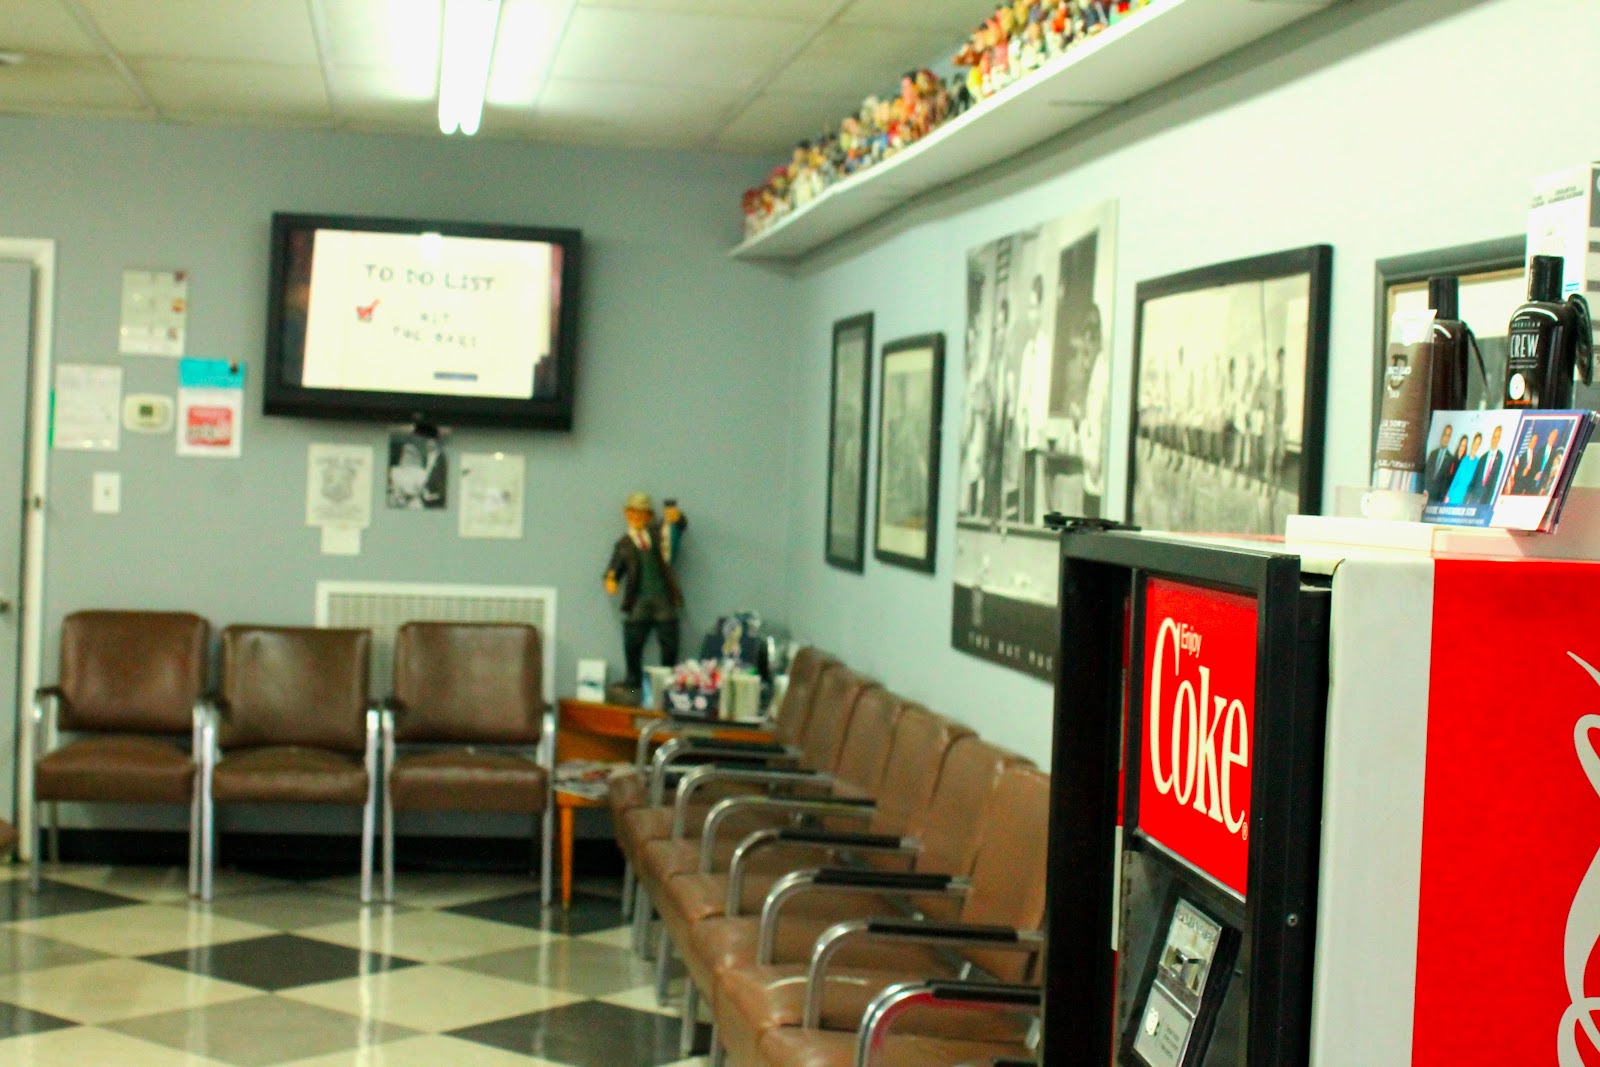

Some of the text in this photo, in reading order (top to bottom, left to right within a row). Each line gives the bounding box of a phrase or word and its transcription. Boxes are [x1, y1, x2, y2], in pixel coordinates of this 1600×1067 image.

[365, 263, 494, 291] TO DO LIST
[1510, 334, 1539, 358] CREW
[1180, 622, 1202, 659] Enjoy
[1150, 617, 1249, 834] Coke
